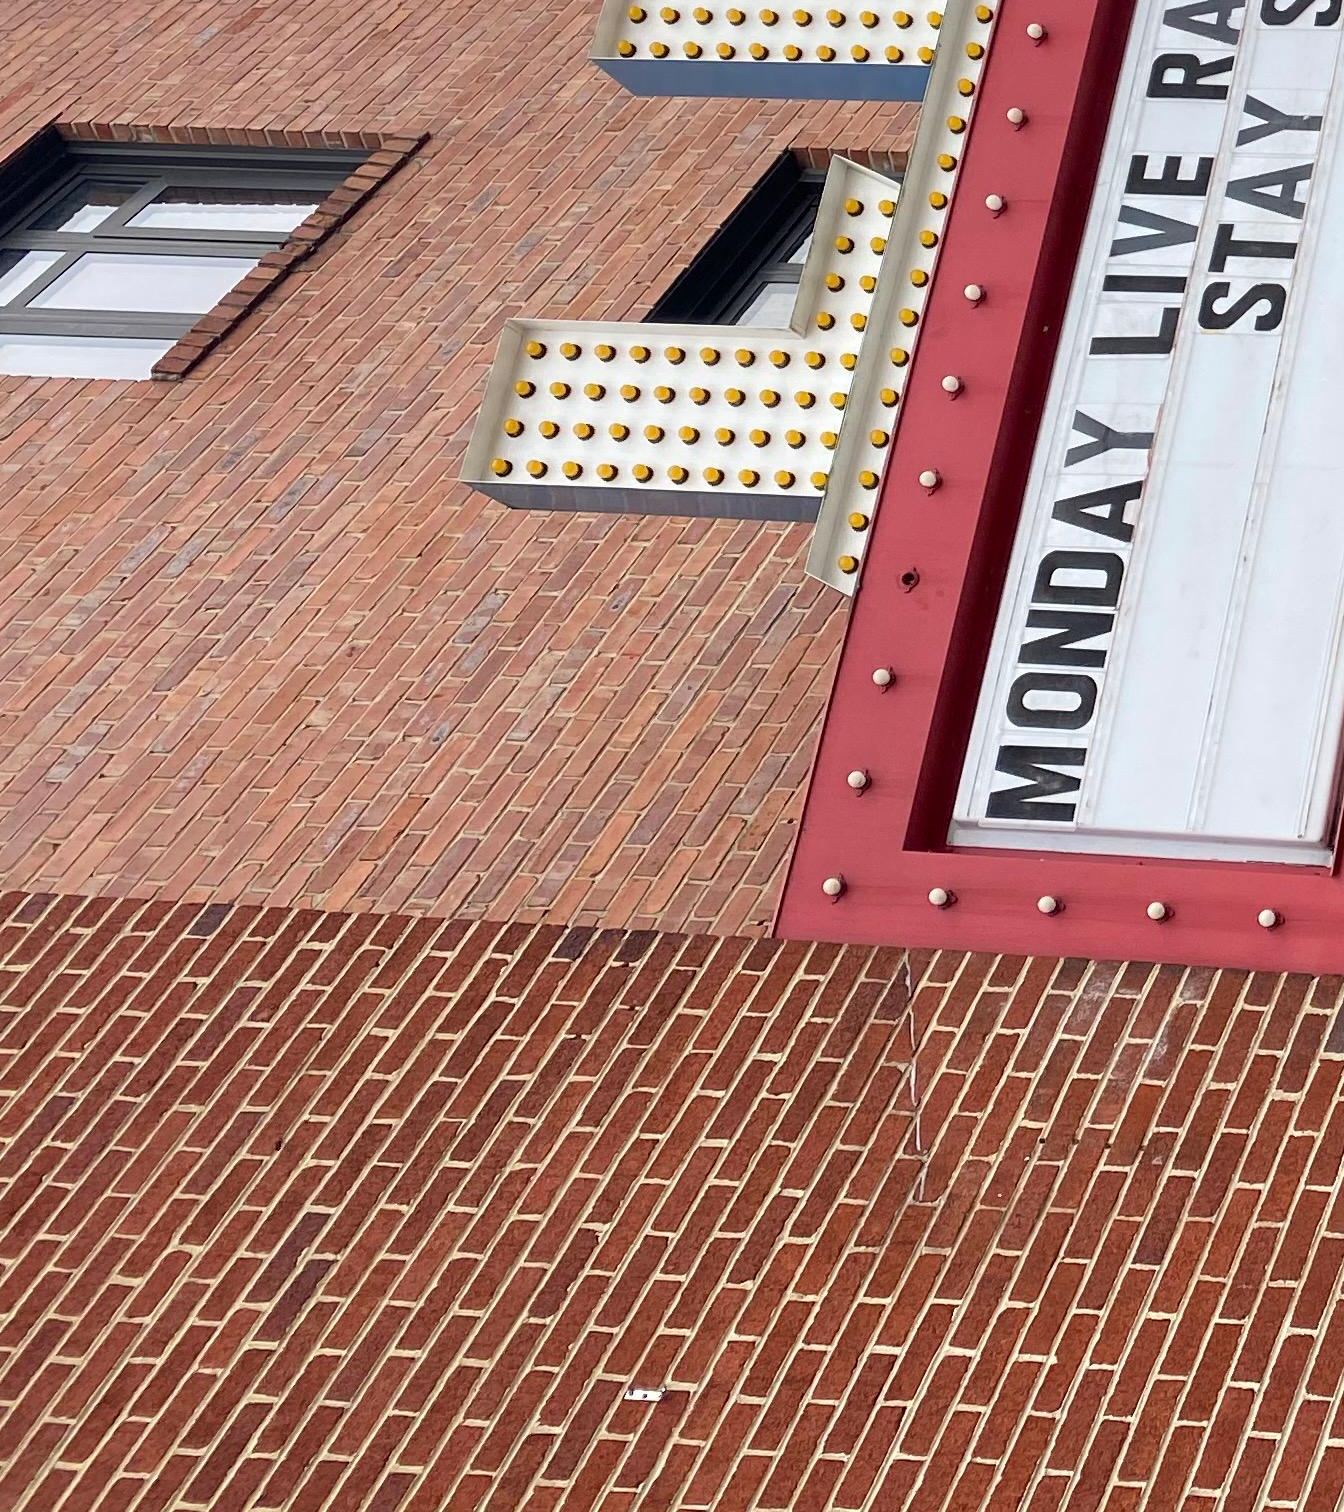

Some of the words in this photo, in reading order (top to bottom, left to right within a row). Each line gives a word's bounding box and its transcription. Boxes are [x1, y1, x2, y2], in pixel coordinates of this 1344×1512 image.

[1198, 94, 1322, 331] STAY
[985, 410, 1153, 822] MONDAY
[1089, 155, 1213, 355] LIVE
